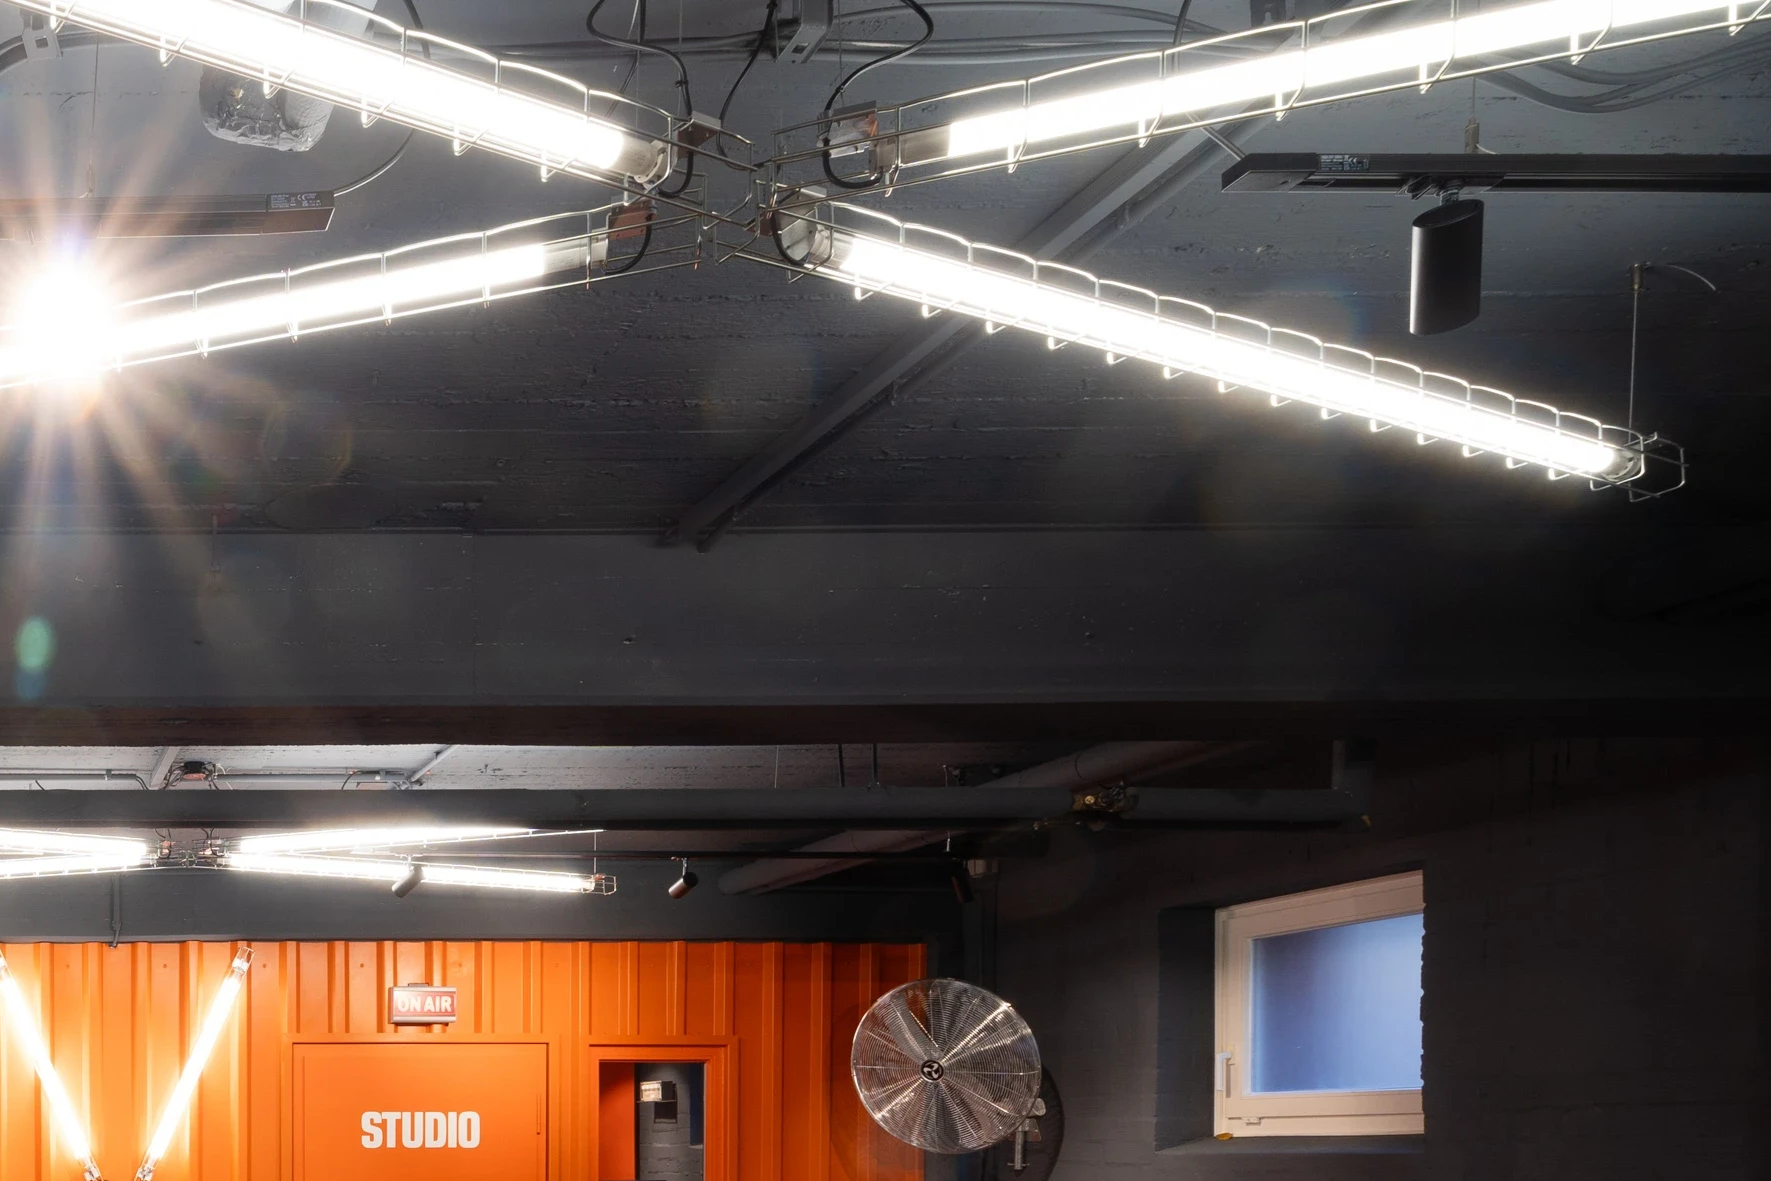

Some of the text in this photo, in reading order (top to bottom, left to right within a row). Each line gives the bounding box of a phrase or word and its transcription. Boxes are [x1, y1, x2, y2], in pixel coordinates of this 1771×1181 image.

[397, 995, 453, 1013] ON AIR
[361, 1111, 481, 1149] STUDIO
